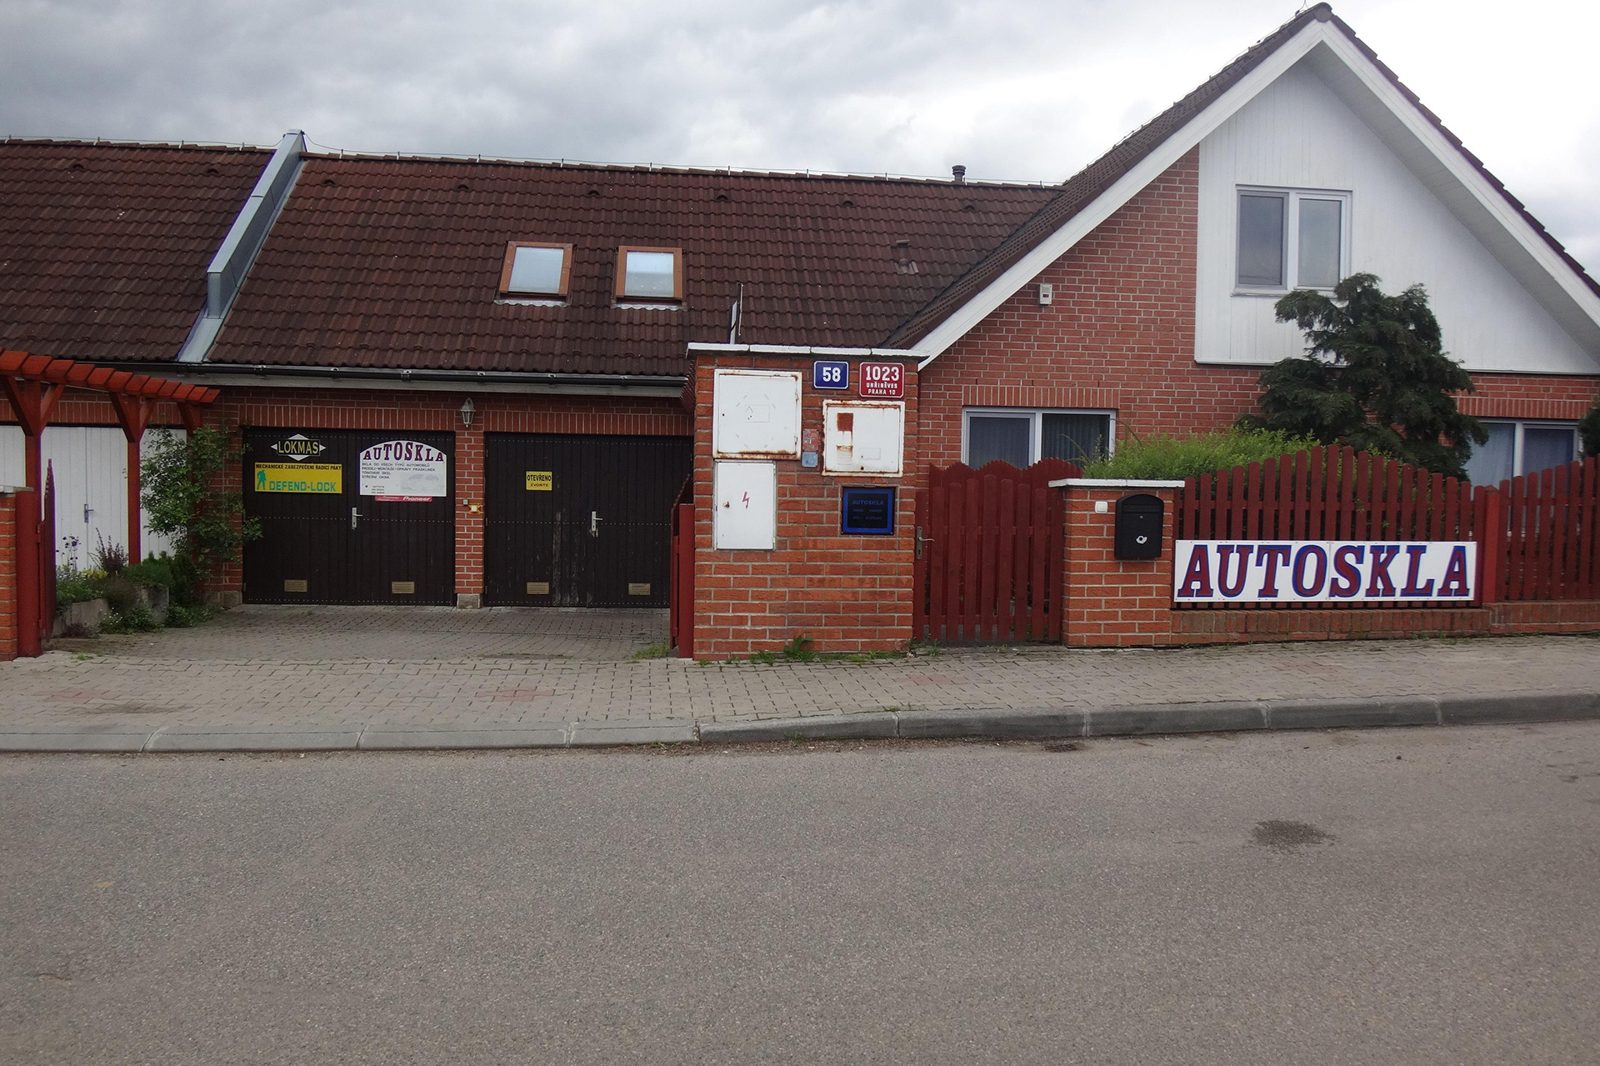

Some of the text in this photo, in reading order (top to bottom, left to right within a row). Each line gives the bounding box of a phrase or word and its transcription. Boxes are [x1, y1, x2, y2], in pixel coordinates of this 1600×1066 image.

[822, 366, 841, 383] 58
[865, 365, 900, 382] 1023
[278, 440, 319, 454] LOKMAS
[363, 442, 444, 462] AUTOSKLA
[269, 480, 337, 492] DEFEND-LOCK
[1176, 543, 1471, 598] AUTOSKLA
